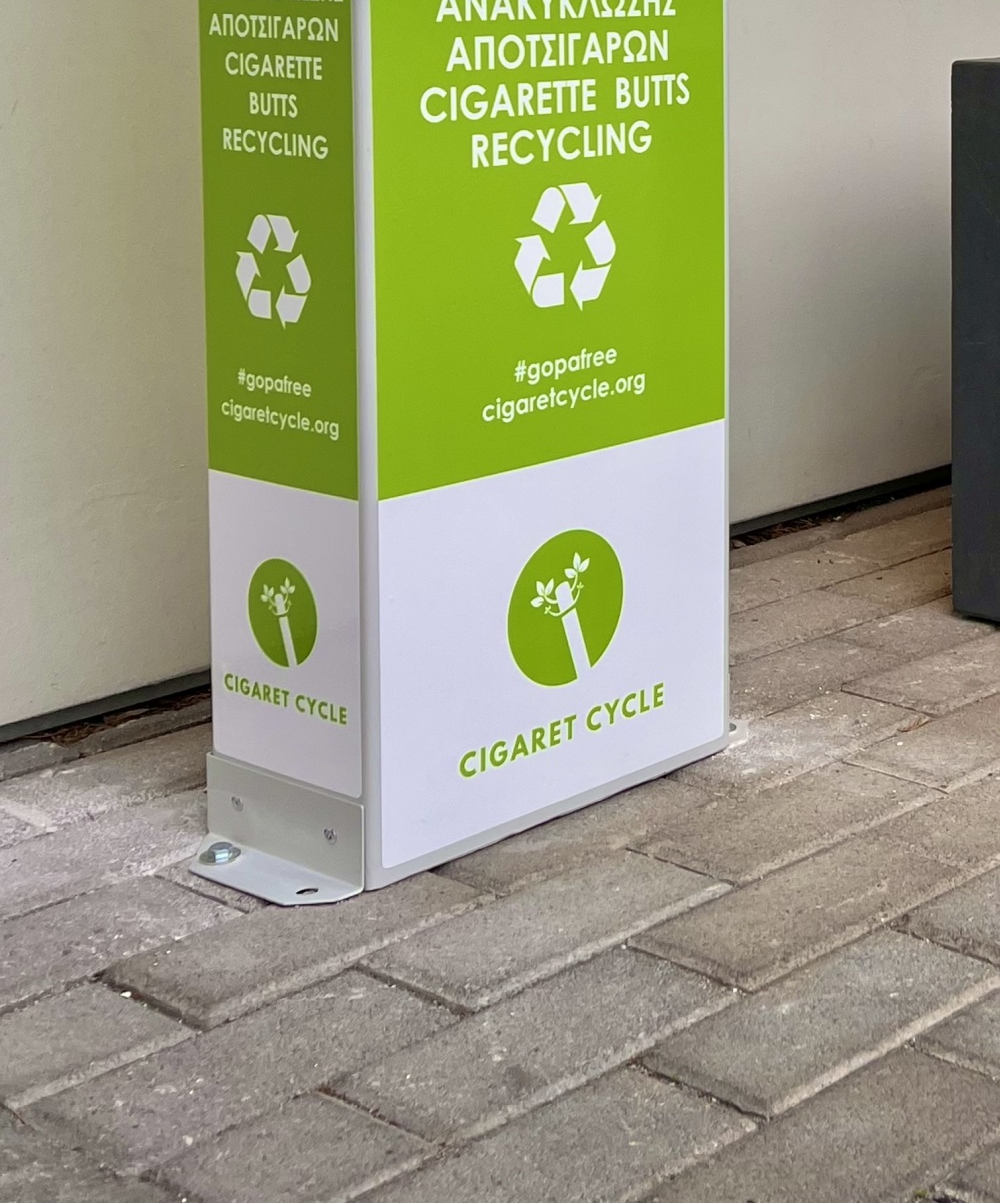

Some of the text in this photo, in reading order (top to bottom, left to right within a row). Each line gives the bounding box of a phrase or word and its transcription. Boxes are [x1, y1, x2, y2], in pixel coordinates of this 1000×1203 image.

[209, 13, 339, 43] ΑΠΟΤΣΙΓΑΡΩΝ
[225, 52, 323, 80] CIGARETTE
[445, 30, 669, 72] ΑΠΟΤΣΙΓΑΡΩΝ
[249, 93, 298, 118] BUTTS
[420, 73, 690, 123] CIGARETTE BUTTS
[222, 128, 329, 160] RECYCLING
[472, 121, 652, 168] RECYCLING
[237, 368, 312, 398] #gopafree
[514, 346, 618, 385] #gopafree
[221, 398, 340, 441] cigaretcycle.org
[482, 373, 646, 424] cigaretcycle.org
[223, 673, 348, 725] CIGARET CYCLE
[459, 682, 665, 779] CIGARET CYCLE
